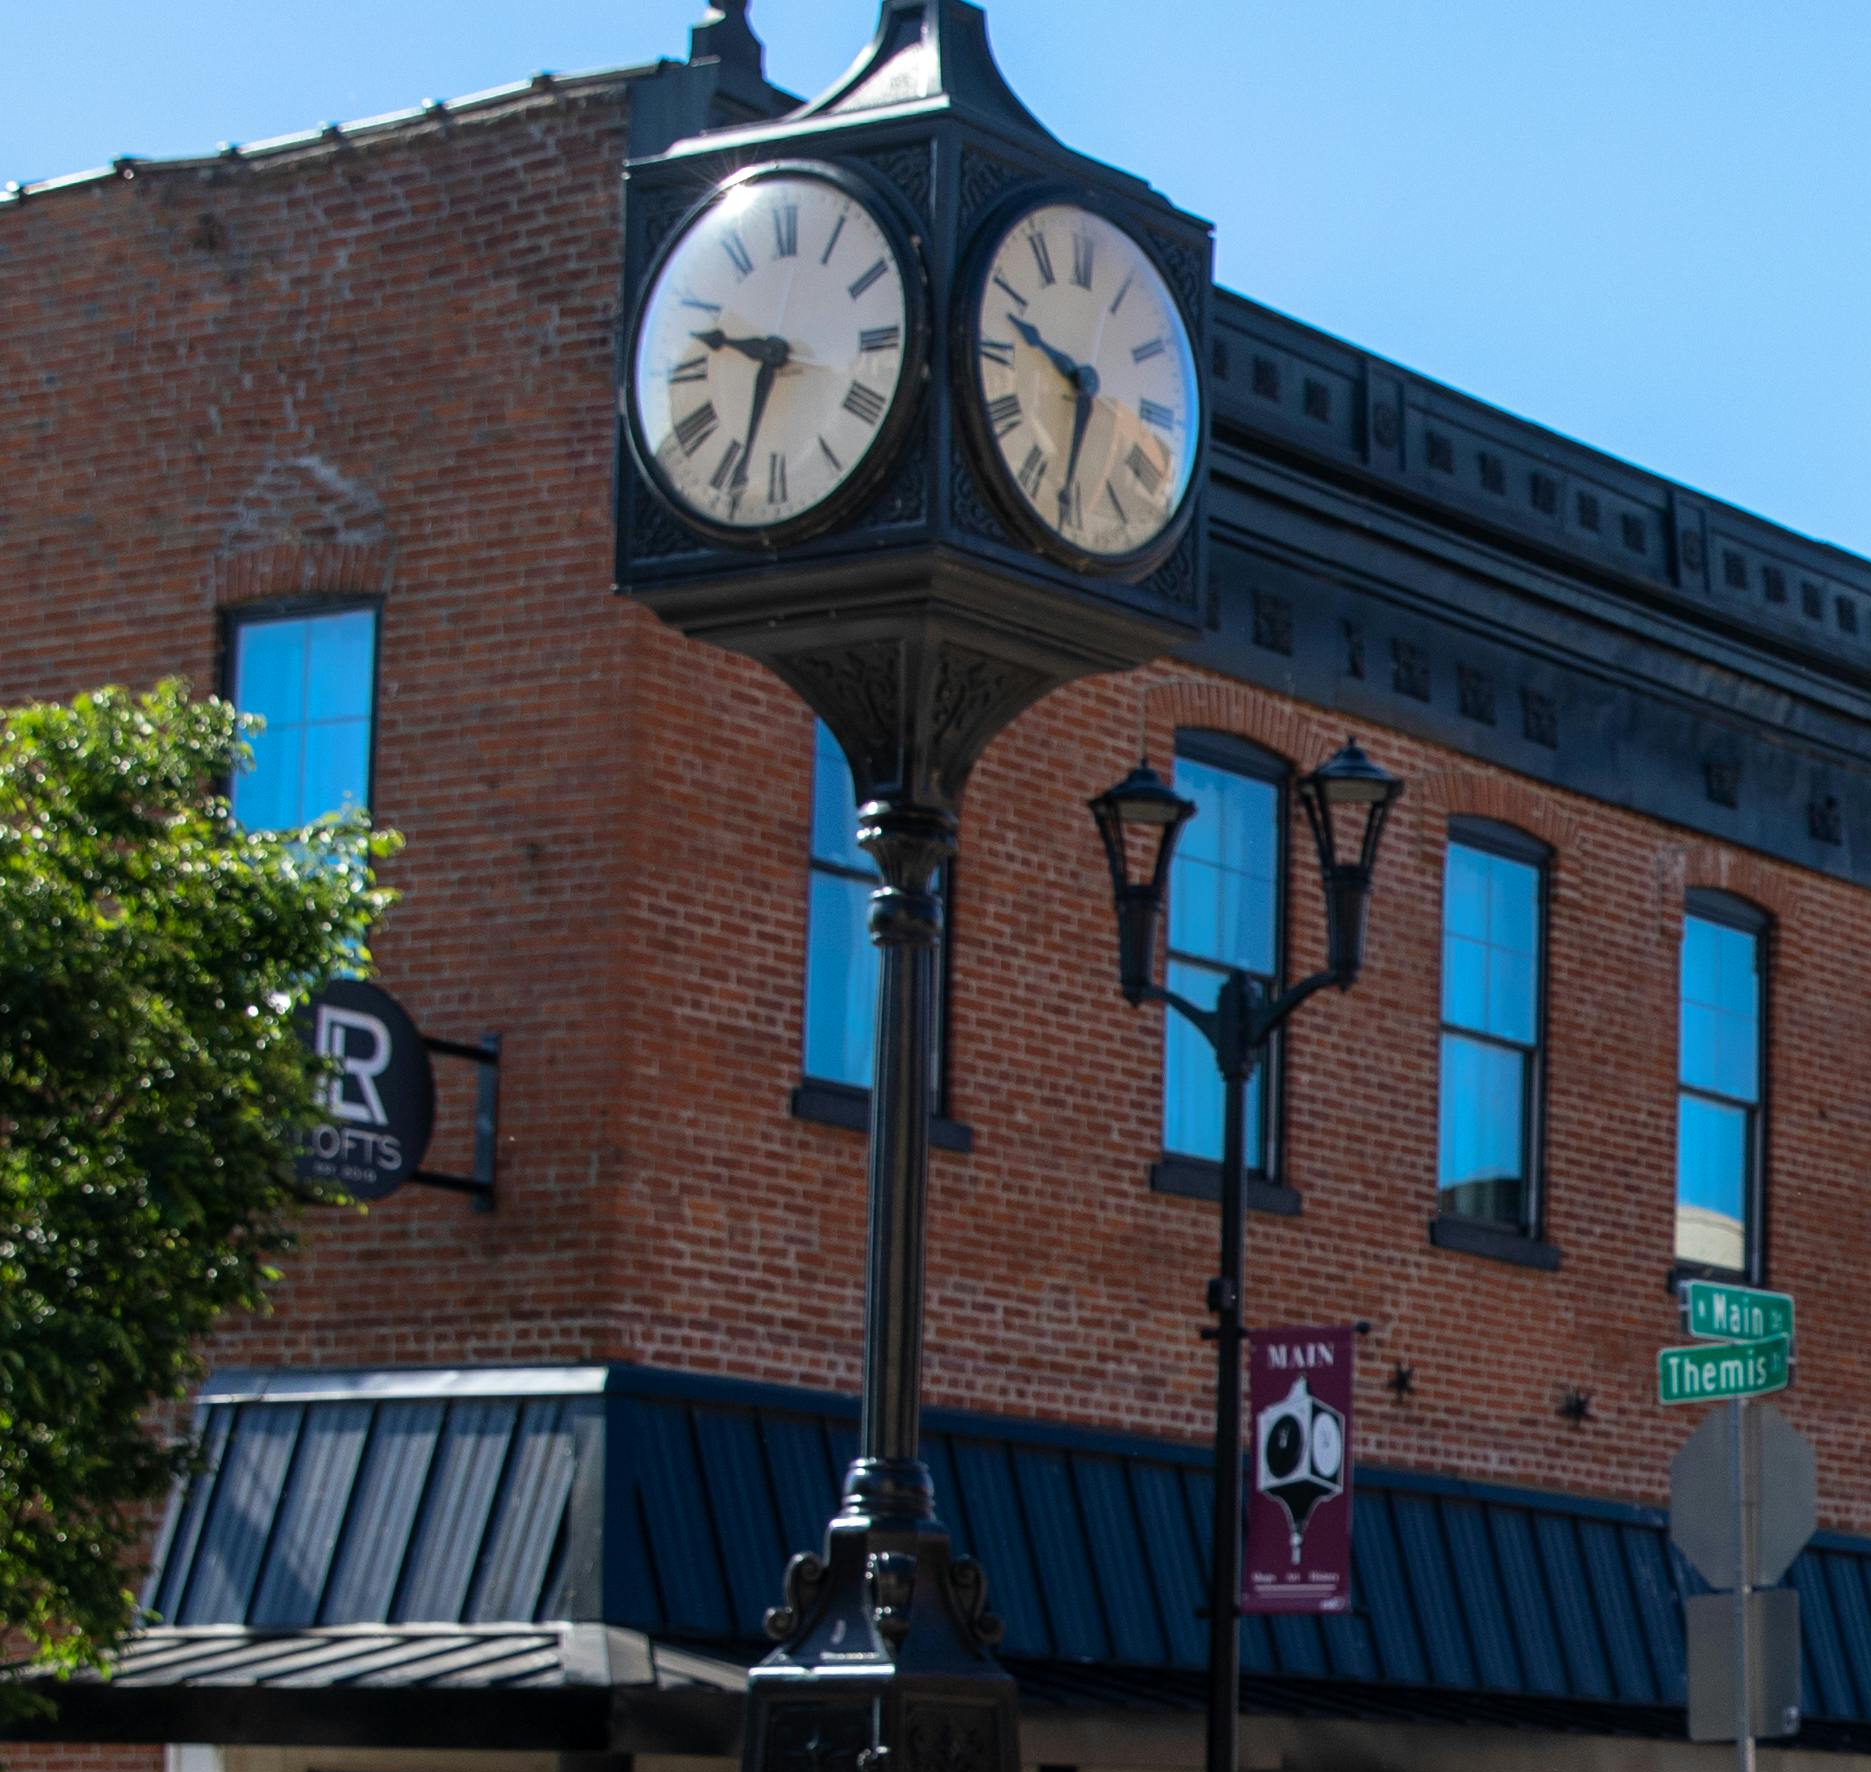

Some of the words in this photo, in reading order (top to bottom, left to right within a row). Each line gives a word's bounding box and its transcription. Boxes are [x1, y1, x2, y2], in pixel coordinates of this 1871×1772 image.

[1713, 1292, 1764, 1336] Main
[1267, 1342, 1335, 1369] MAIN
[1668, 1350, 1767, 1394] Themis
